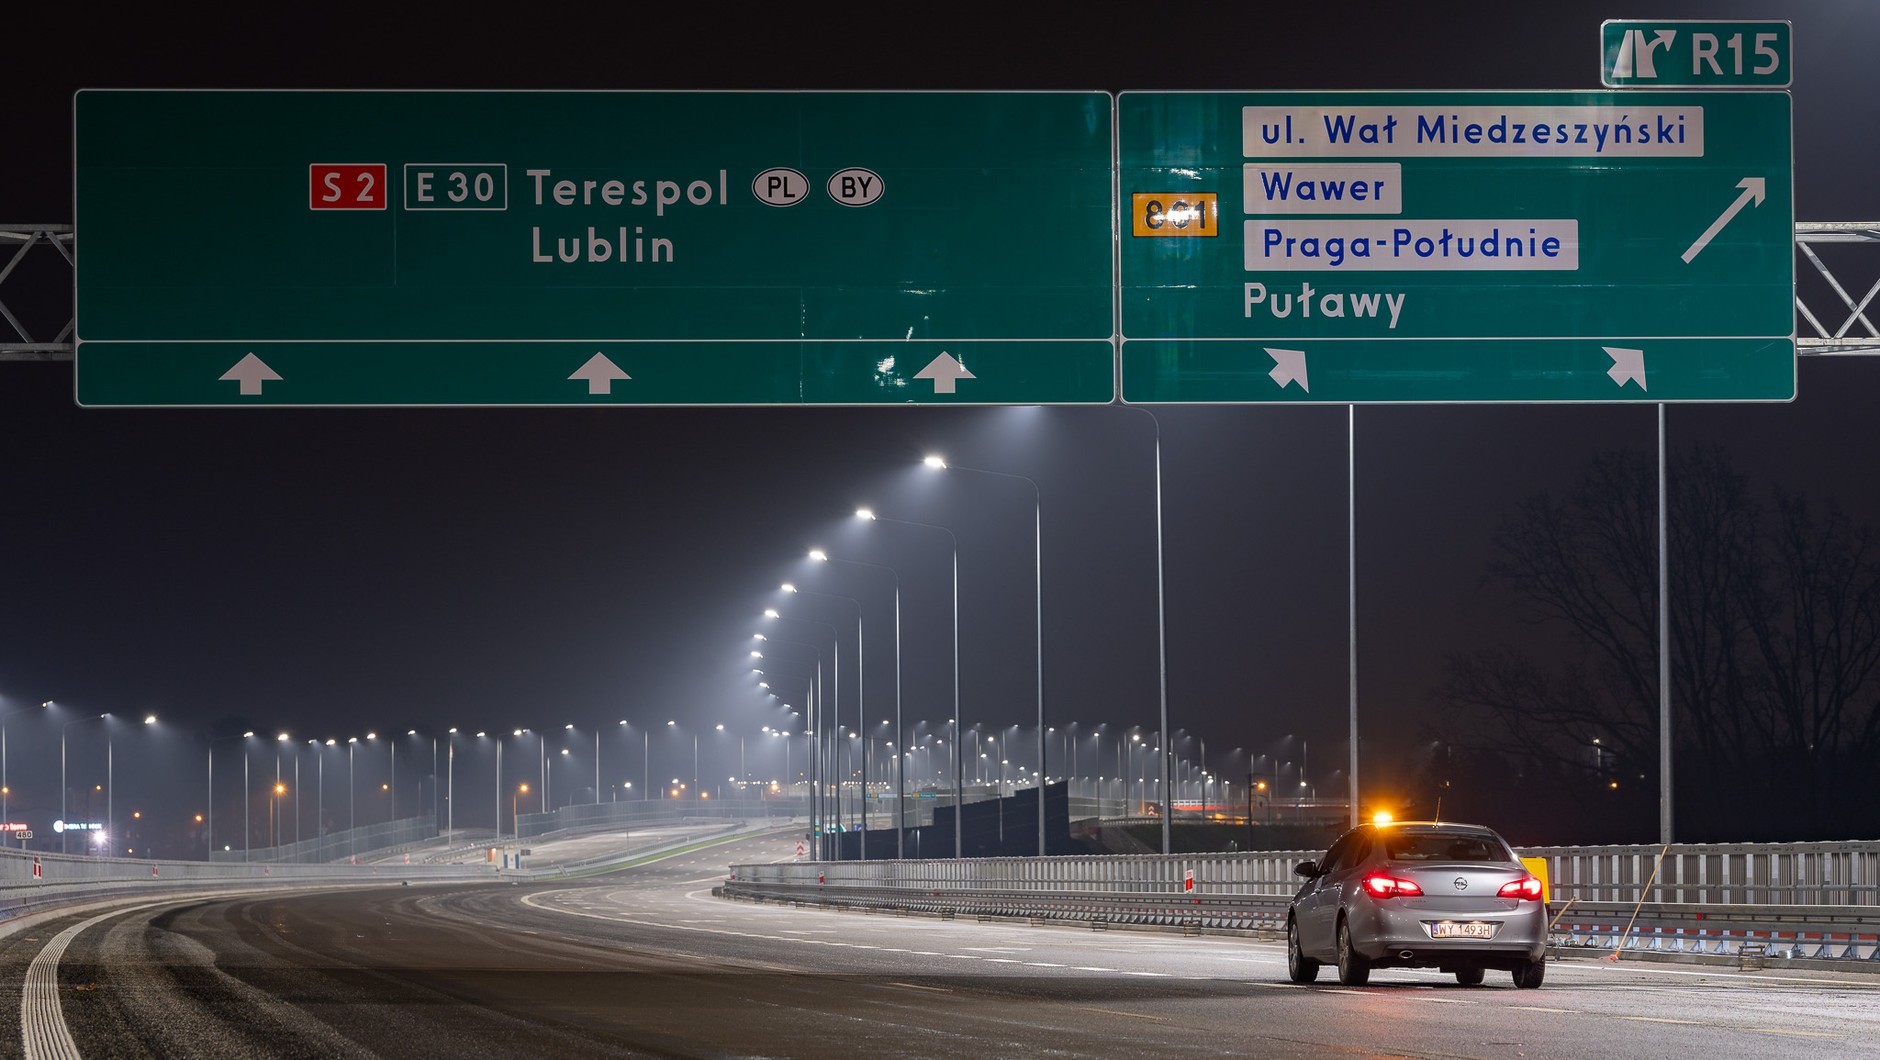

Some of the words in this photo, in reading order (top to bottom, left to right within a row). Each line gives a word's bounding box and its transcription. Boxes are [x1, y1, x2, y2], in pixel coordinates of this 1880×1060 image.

[1692, 33, 1779, 75] R15
[1262, 115, 1305, 145] ul.
[1323, 115, 1397, 144] Wał
[1417, 114, 1685, 153] Miedzeszyński
[322, 172, 342, 202] S
[356, 172, 375, 202] 2
[417, 172, 434, 202] E
[447, 171, 494, 202] 30
[526, 169, 727, 217] Terespol
[767, 176, 796, 198] PL
[841, 176, 873, 198] BY
[1260, 172, 1385, 201] Wawer
[532, 226, 675, 263] Lublin
[1263, 227, 1561, 267] Praga-Południe
[1244, 282, 1406, 329] Puławy
[1438, 924, 1454, 935] WY
[1459, 924, 1490, 936] 1493H
